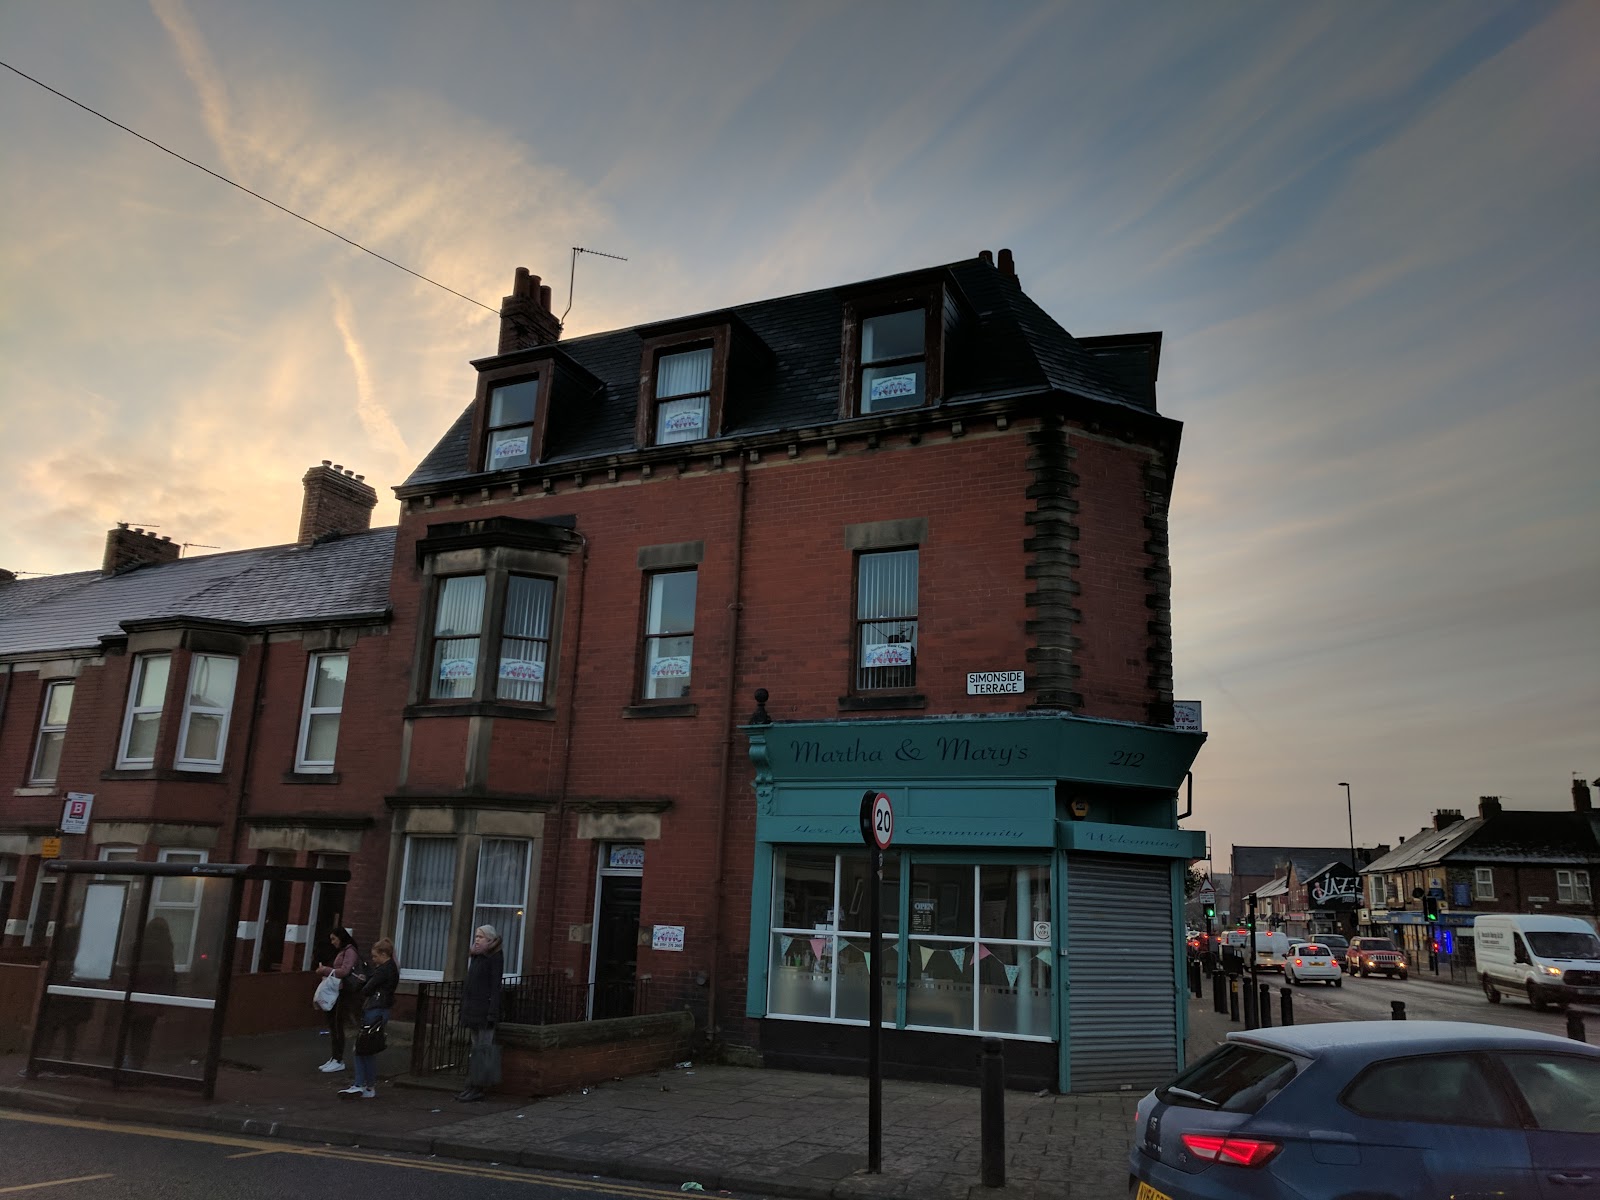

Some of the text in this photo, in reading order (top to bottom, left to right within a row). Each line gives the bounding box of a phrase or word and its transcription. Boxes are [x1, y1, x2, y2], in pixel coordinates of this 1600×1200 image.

[969, 672, 1022, 683] SIMONSIDE
[973, 683, 1018, 693] TERRACE
[790, 737, 1029, 767] Martha & Mary's
[1109, 750, 1145, 767] 212
[876, 808, 891, 833] 20
[792, 825, 833, 833] Here
[905, 826, 1024, 838] Community
[1085, 832, 1181, 849] Welcoming
[914, 902, 934, 910] OPEN
